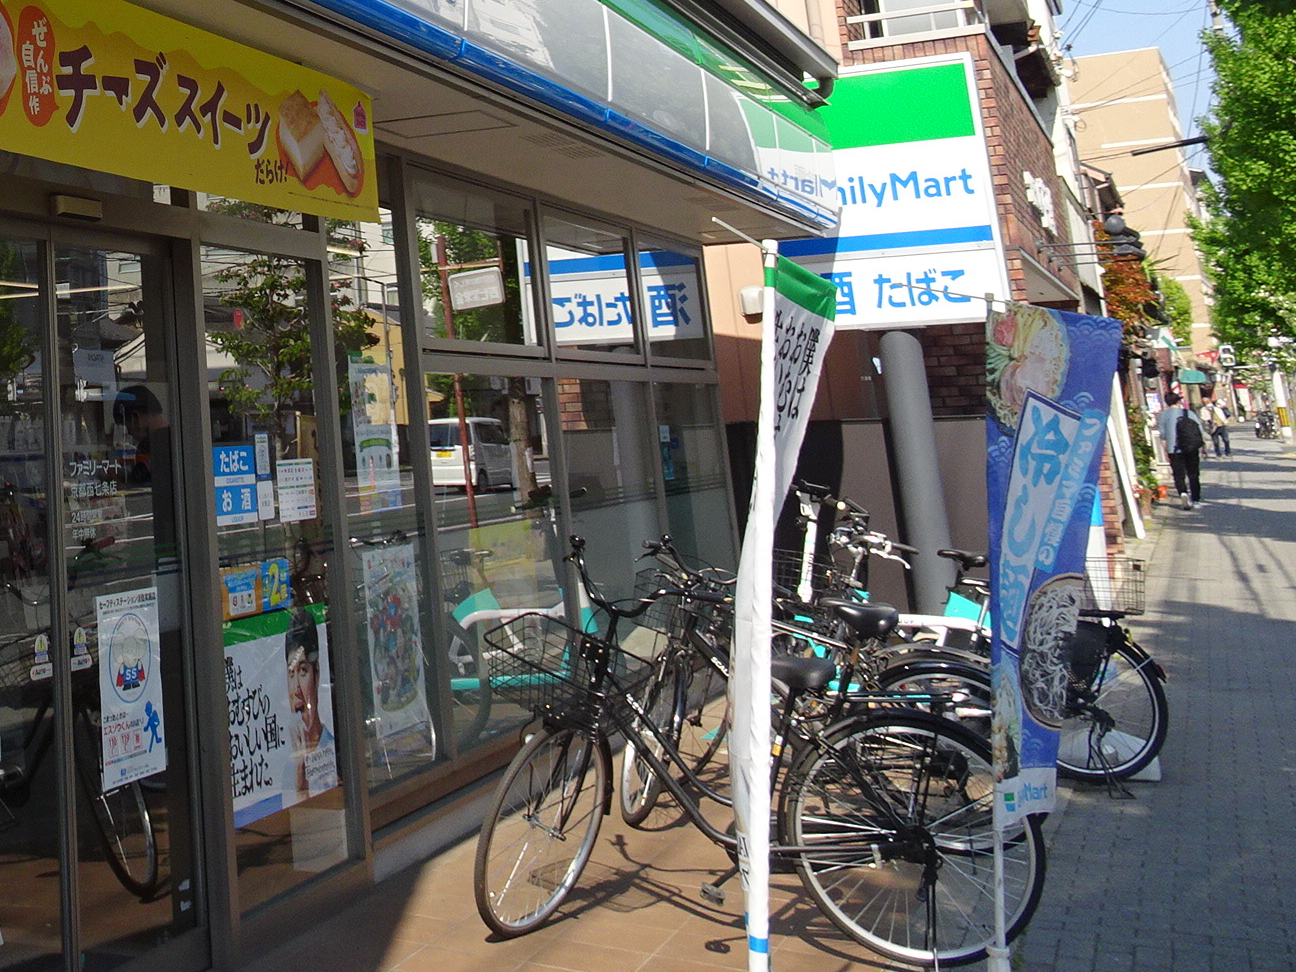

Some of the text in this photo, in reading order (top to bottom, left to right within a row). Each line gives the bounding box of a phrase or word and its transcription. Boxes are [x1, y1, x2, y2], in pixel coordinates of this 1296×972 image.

[31, 17, 52, 95] ぜんぶ
[21, 40, 40, 115] 自信作
[56, 44, 270, 158] チーズスイーツ
[873, 268, 972, 309] たばこ
[69, 459, 122, 476] ファミリーマート
[219, 449, 249, 473] たばこ
[125, 668, 137, 680] SS
